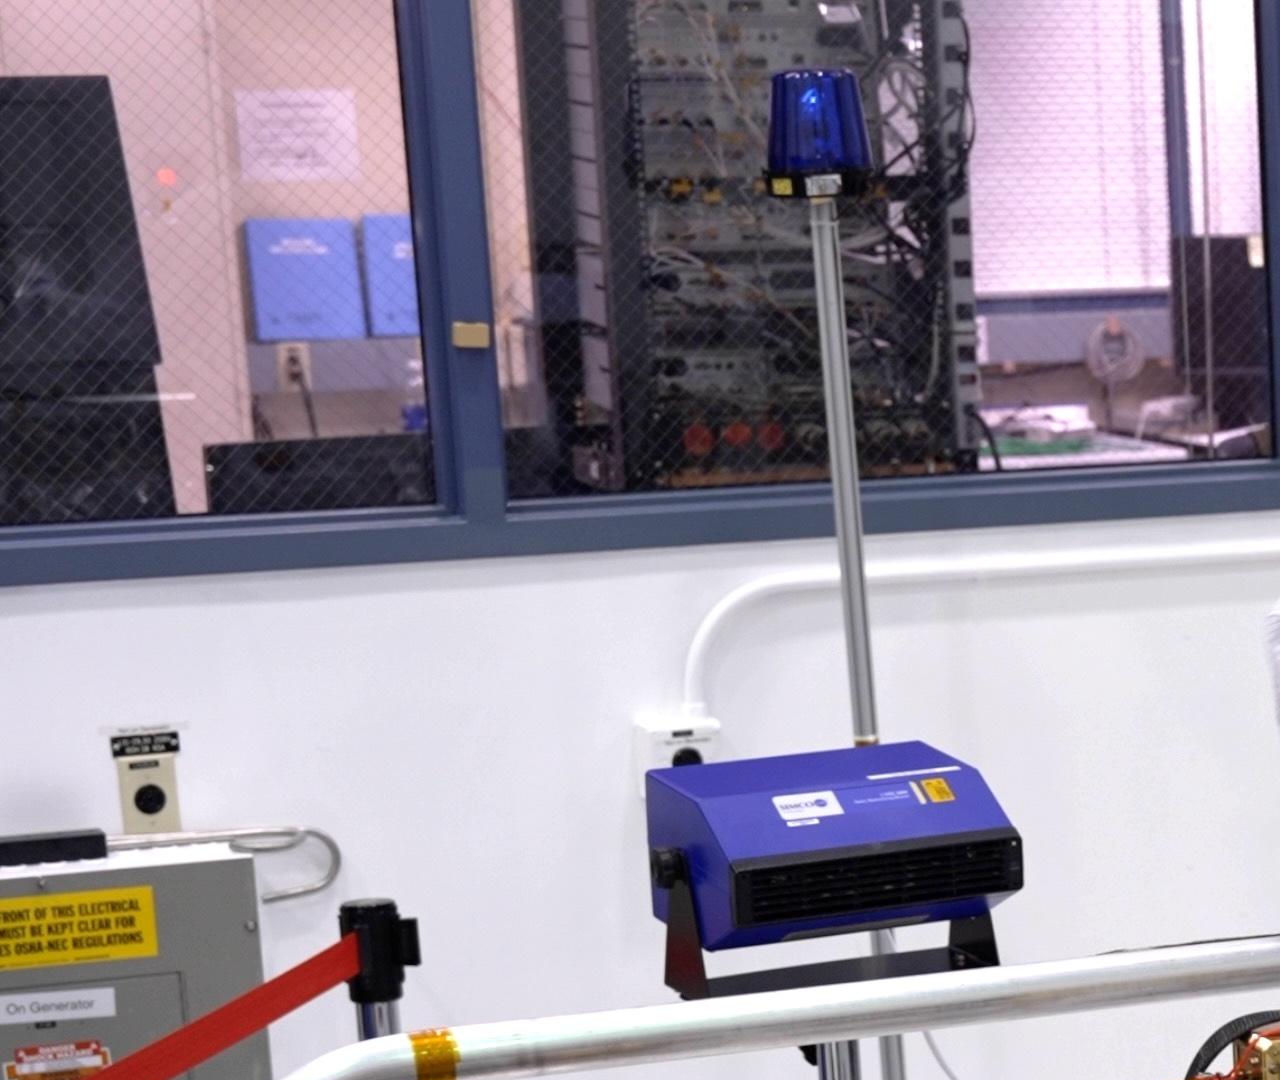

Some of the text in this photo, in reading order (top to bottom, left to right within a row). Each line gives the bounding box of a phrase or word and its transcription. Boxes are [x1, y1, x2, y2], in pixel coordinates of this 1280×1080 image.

[34, 907, 47, 920] OF
[52, 905, 75, 918] THIS
[79, 899, 141, 916] ELECTRICAL
[0, 915, 136, 939] MUST BE KEPT CLEAR FOR
[0, 931, 144, 957] ES OSHA-NEC REGULATIONS
[6, 999, 94, 1015] On Generator
